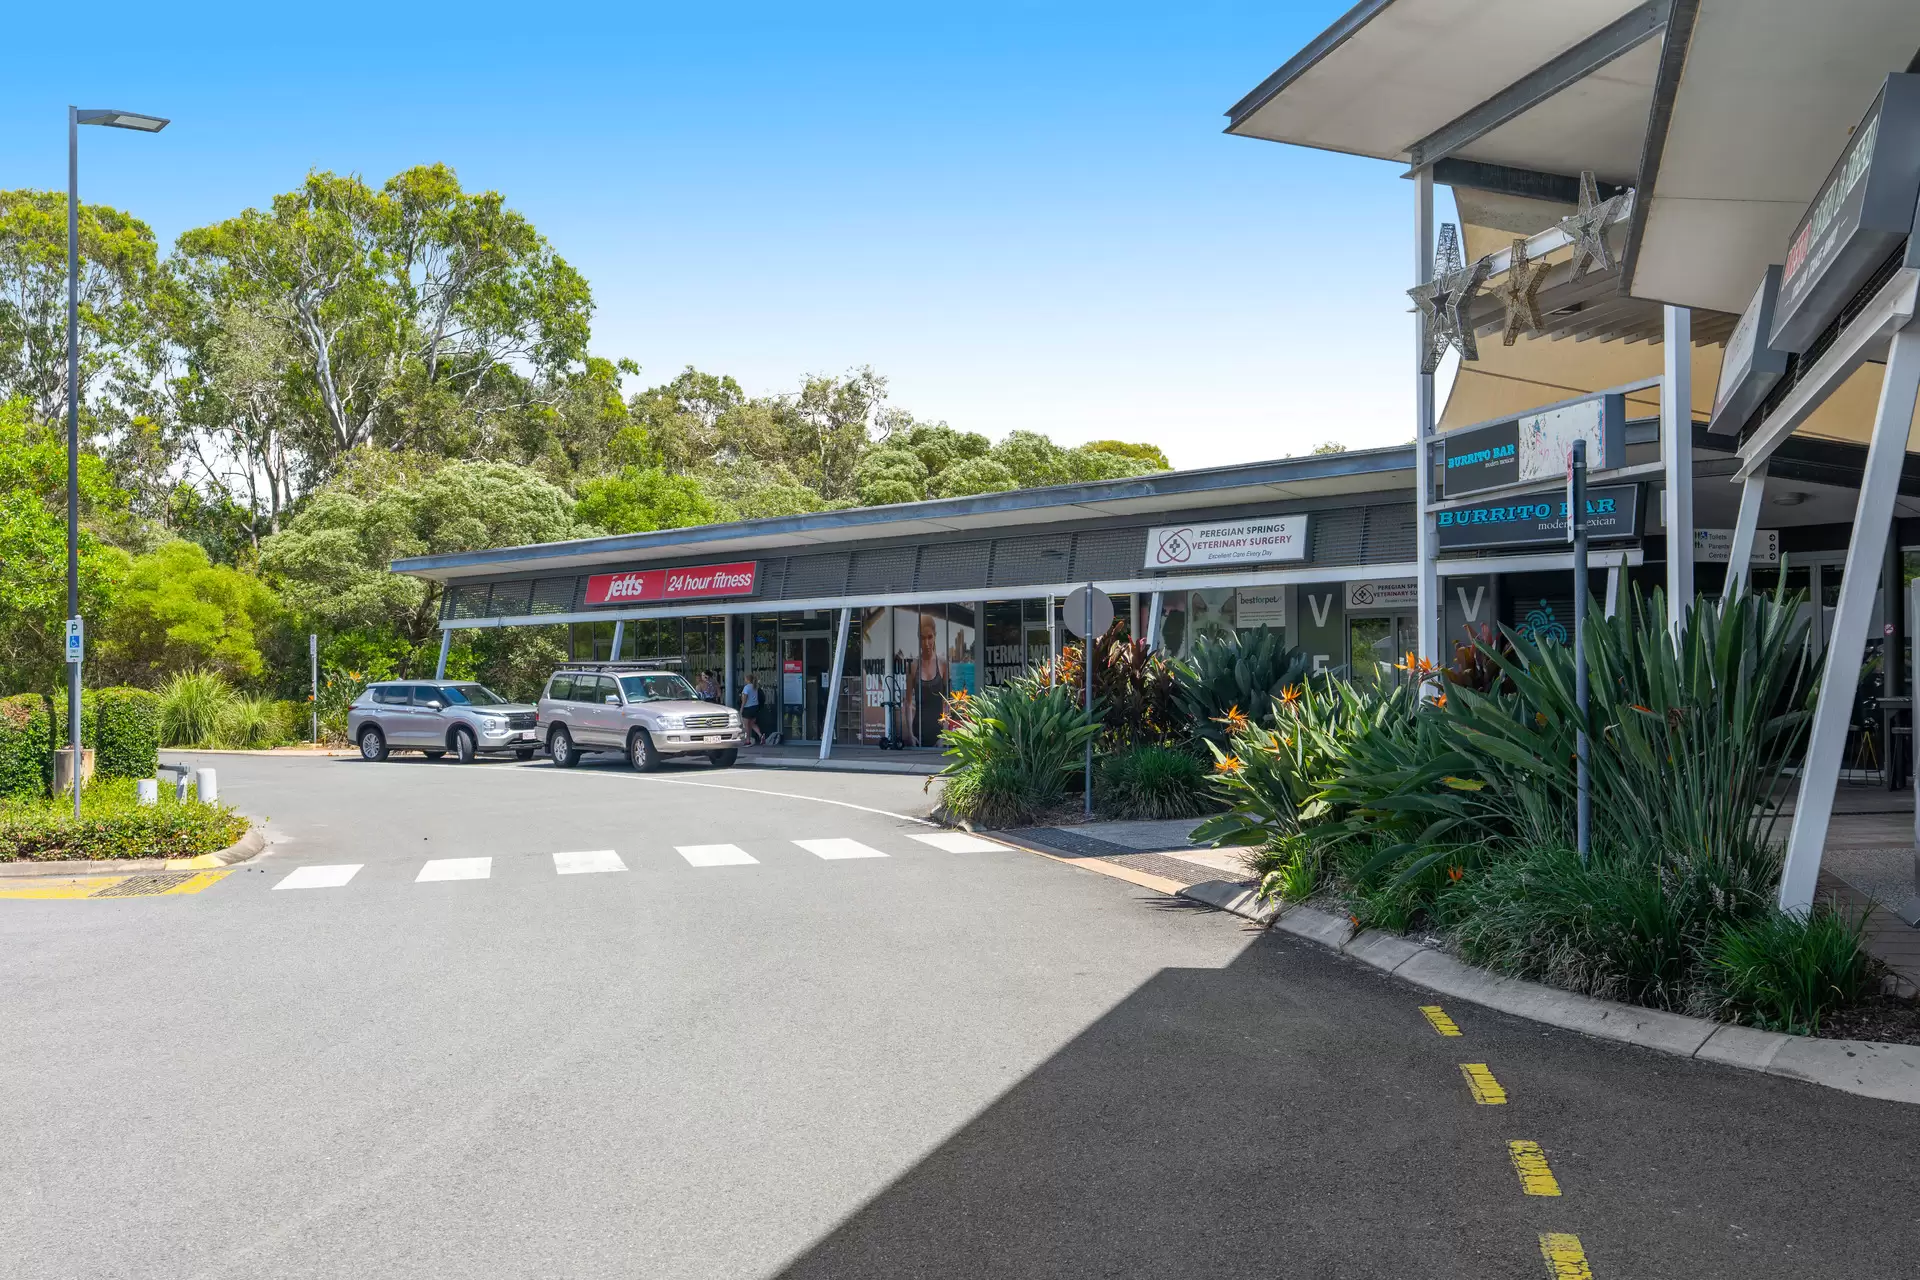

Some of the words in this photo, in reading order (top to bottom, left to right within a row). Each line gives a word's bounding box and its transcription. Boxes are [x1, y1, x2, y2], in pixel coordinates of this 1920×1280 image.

[1448, 449, 1491, 469] BURRITO
[1493, 443, 1515, 459] BAR
[1438, 503, 1551, 527] BURRITO
[1200, 527, 1245, 538] PEREGIAN
[1246, 523, 1286, 535] SPRINGS
[1538, 519, 1568, 530] moder
[1587, 516, 1616, 527] exican
[1192, 538, 1247, 550] VETERINARY
[1249, 535, 1293, 546] SURGERY
[1708, 533, 1728, 541] Toilets
[1208, 551, 1232, 560] Excellent
[1233, 550, 1246, 558] Care
[1246, 549, 1262, 558] Every
[1262, 548, 1273, 557] Day
[604, 574, 644, 602] jetts
[667, 574, 684, 592] 24
[684, 574, 714, 591] hour
[712, 571, 752, 589] fitness
[71, 624, 78, 634] P
[865, 674, 879, 690] ON
[880, 674, 907, 690] YUR
